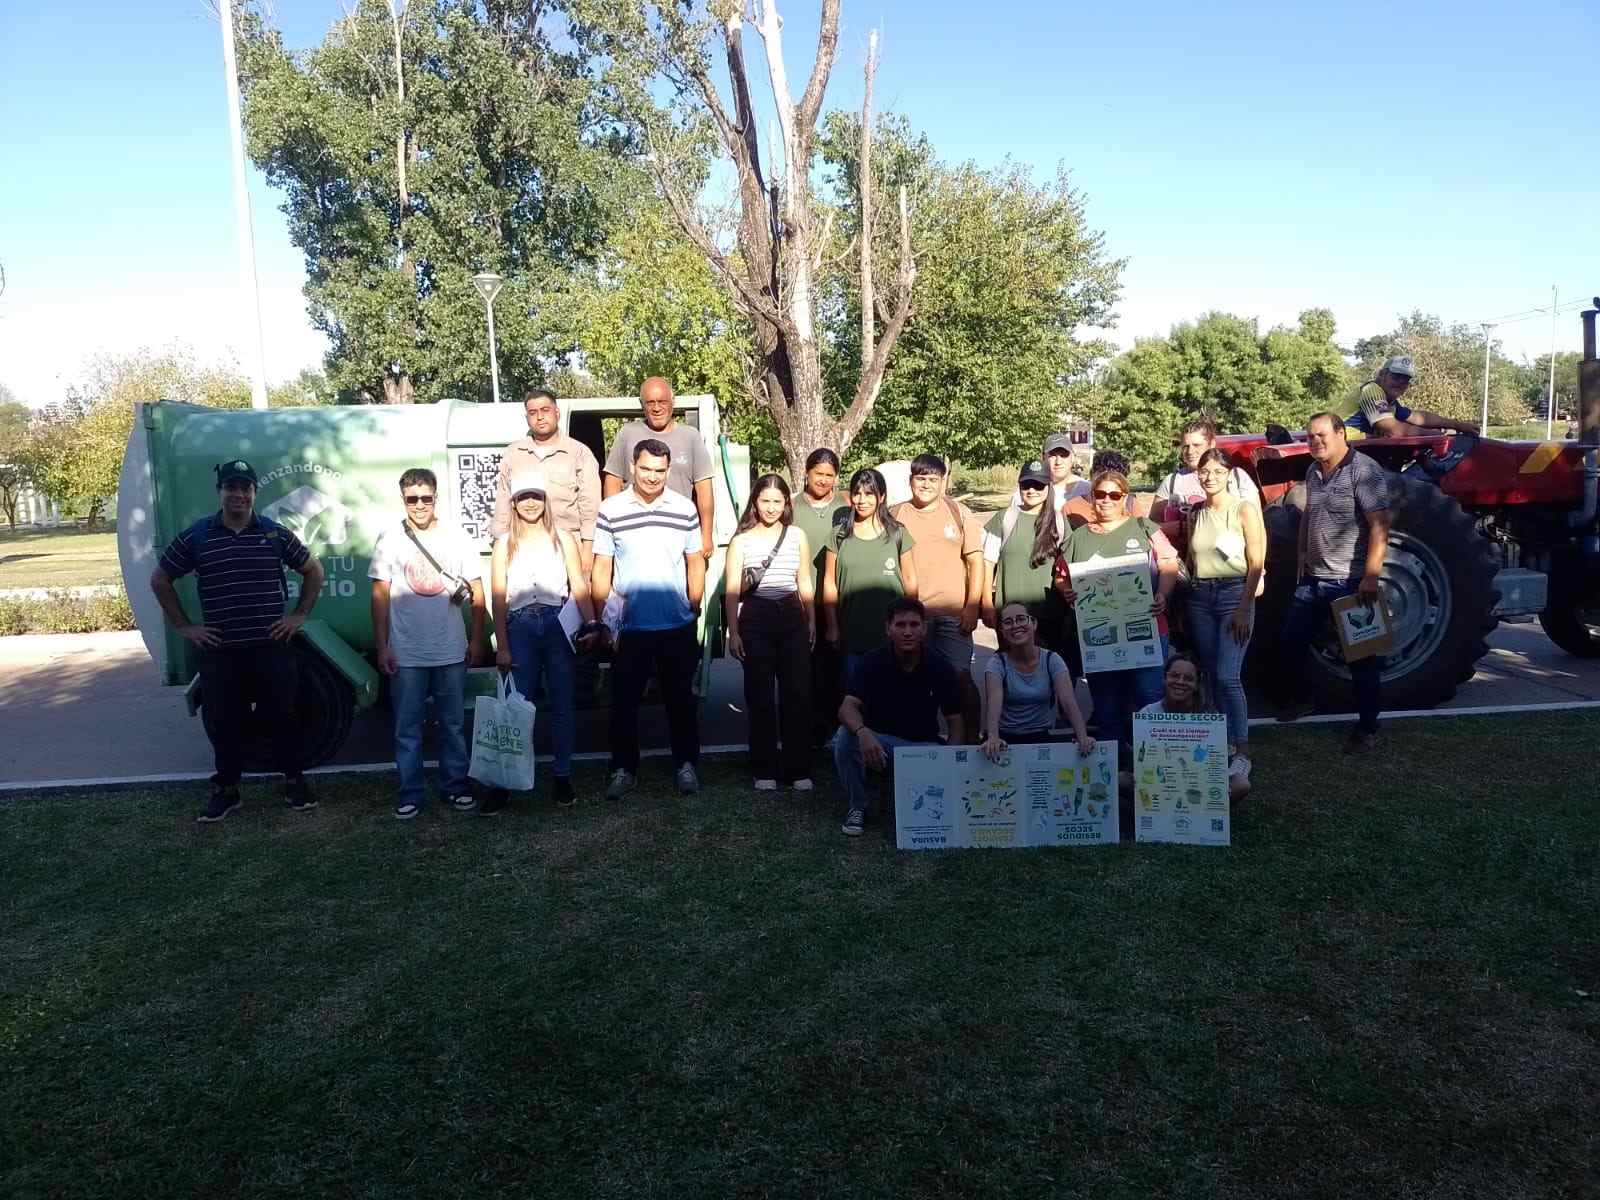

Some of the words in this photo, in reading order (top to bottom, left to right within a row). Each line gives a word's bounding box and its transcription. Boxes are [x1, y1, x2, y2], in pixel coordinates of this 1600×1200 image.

[328, 556, 354, 572] TU
[1135, 712, 1186, 721] RESIDUOS
[1190, 713, 1225, 722] SECOS
